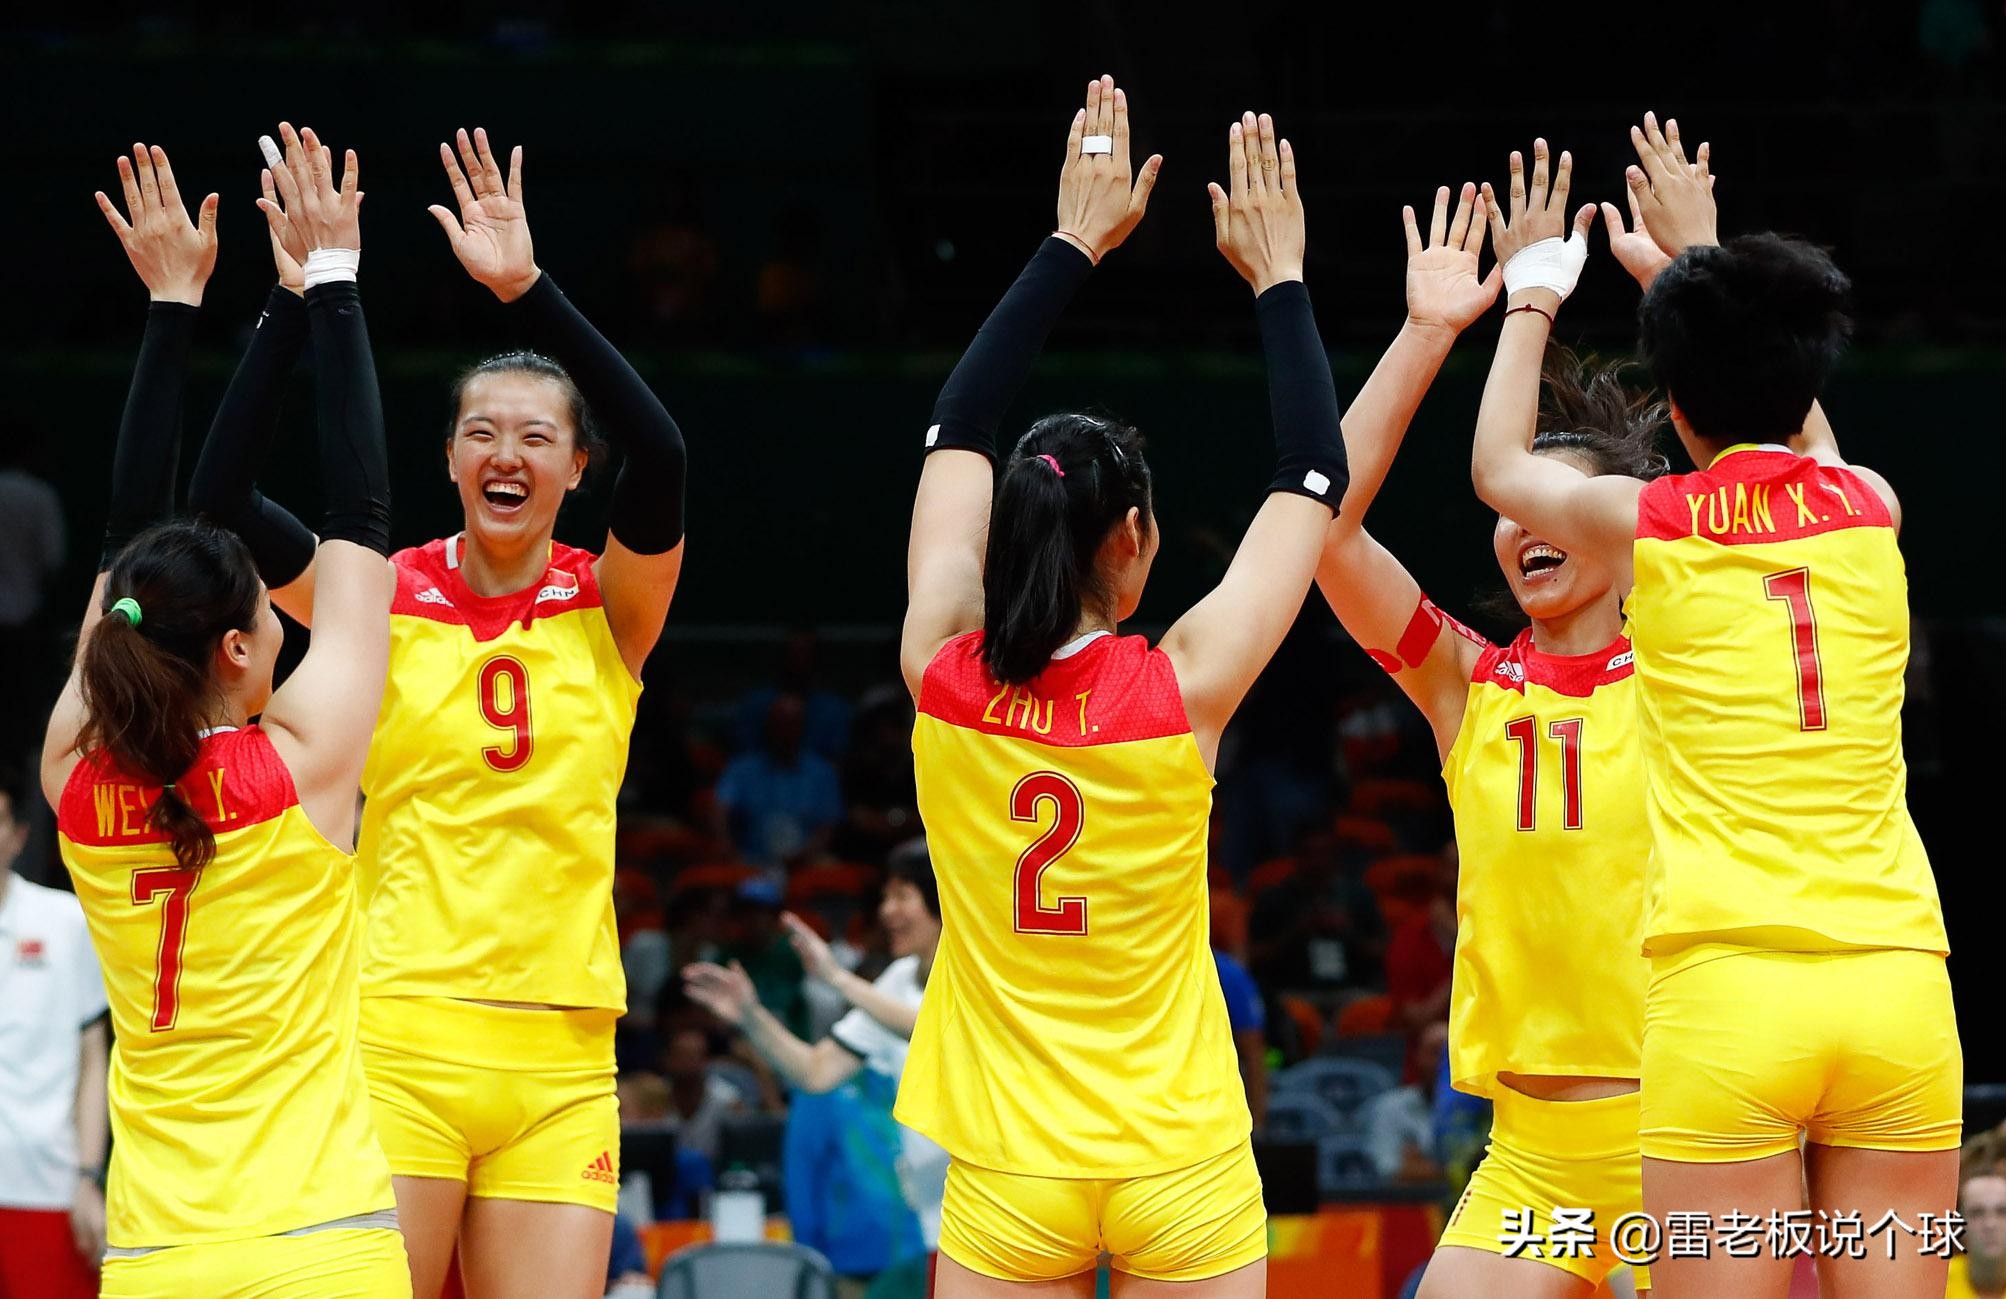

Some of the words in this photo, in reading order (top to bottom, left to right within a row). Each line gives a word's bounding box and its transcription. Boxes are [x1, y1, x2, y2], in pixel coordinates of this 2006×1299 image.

[1686, 482, 1776, 535] YUAN
[540, 589, 574, 598] CHN
[1763, 566, 1827, 731] 1
[477, 654, 534, 773] 9
[981, 679, 1054, 735] ZHU
[1075, 688, 1099, 737] T.
[1505, 715, 1583, 831] 11
[1010, 770, 1088, 936] 2
[131, 865, 201, 1033] 7
